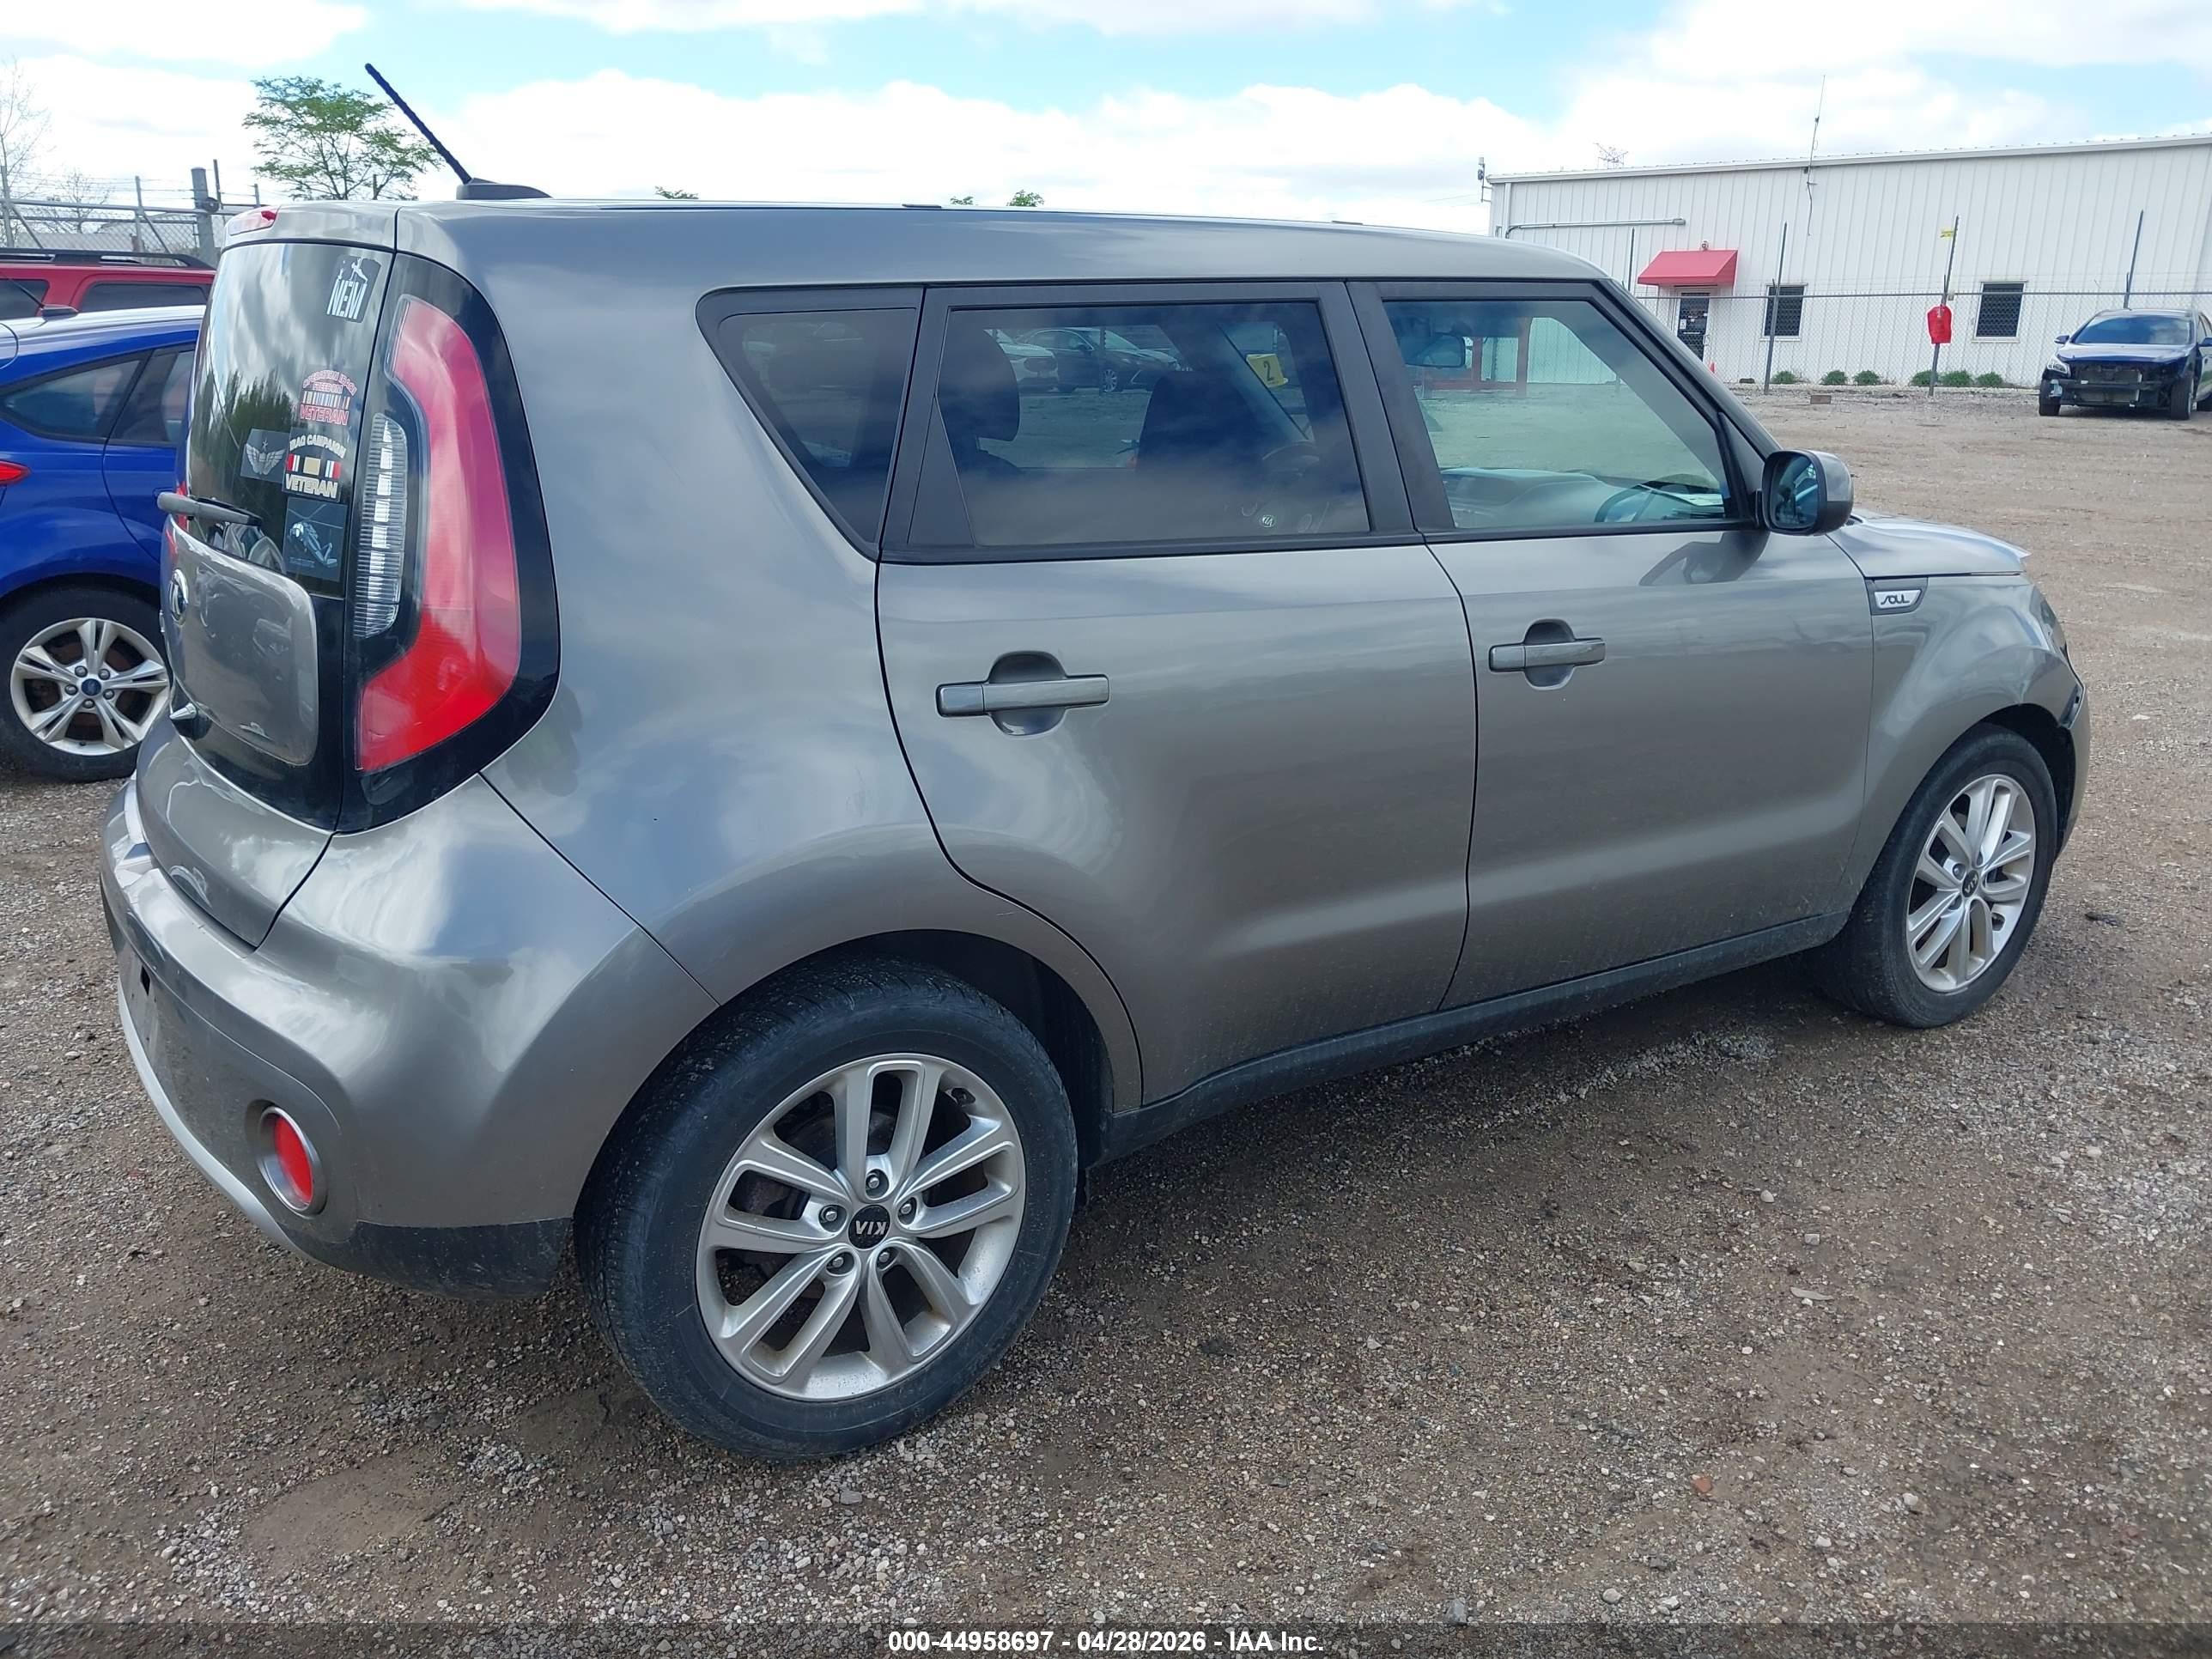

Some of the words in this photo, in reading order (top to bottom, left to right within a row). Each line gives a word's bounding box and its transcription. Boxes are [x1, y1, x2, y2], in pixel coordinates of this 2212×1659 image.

[1263, 361, 1274, 380] 2
[313, 382, 343, 394] FREEDOM
[300, 404, 349, 426] VETERAN
[289, 435, 307, 452] IRAQ
[307, 434, 346, 459] CAMPAIGN
[285, 473, 338, 499] VETERAN
[855, 1220, 887, 1236] KIA
